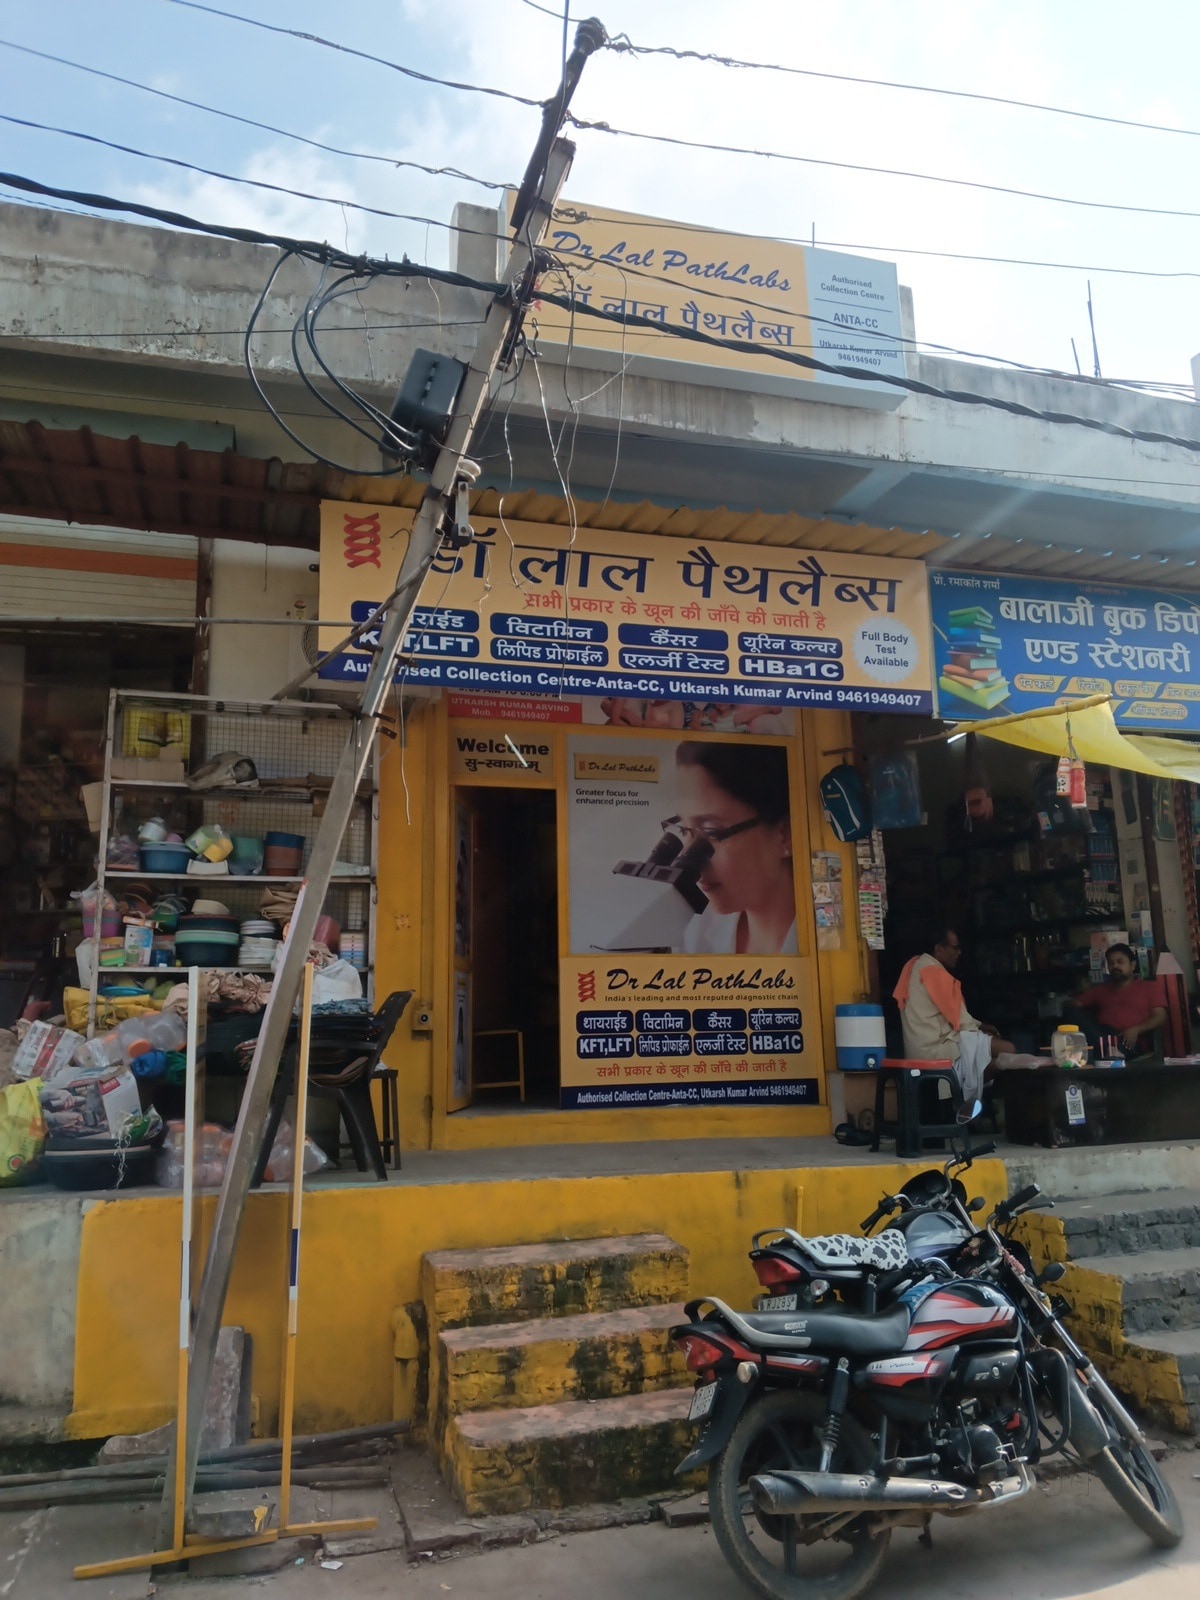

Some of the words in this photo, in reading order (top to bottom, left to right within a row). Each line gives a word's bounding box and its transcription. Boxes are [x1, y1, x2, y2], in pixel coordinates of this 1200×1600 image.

[552, 231, 594, 256] Dr
[599, 241, 655, 267] Lal
[663, 249, 792, 291] PathLabs
[832, 274, 872, 288] Authorised
[821, 283, 858, 296] Collection
[860, 290, 885, 300] Centre
[601, 296, 668, 323] लाल
[680, 300, 795, 348] पैथलैब्स
[833, 312, 878, 328] ANTA-CC
[820, 340, 848, 350] Utkarsh
[837, 353, 881, 365] 9461949407
[514, 544, 654, 593] लाल
[677, 545, 903, 613] पैथलैब्स
[526, 590, 561, 610] सभी
[570, 593, 615, 613] प्रकार
[621, 596, 637, 615] के
[643, 602, 674, 623] खून
[681, 602, 701, 621] की
[746, 606, 767, 625] की
[772, 610, 809, 629] जाती
[812, 612, 828, 631] है
[999, 596, 1094, 627] बालाजी
[1102, 605, 1146, 635] बुक
[506, 615, 593, 639] विटामिन
[359, 629, 474, 652] KT,LFT
[743, 634, 785, 654] यूरिन
[790, 638, 837, 654] कल्चर
[861, 631, 880, 642] Full
[884, 633, 909, 645] Body
[497, 638, 541, 658] लिपिड
[545, 641, 603, 664] प्रोफाईल
[875, 645, 896, 655] Test
[1024, 638, 1079, 664] एण्ड
[1088, 638, 1191, 673] स्टेशनरी
[623, 651, 682, 671] एलर्जी
[687, 653, 725, 672] टेस्ट
[744, 657, 840, 679] HBa1C
[863, 655, 909, 668] Available
[343, 659, 440, 678] Aurised
[446, 667, 532, 684] Collection
[669, 681, 729, 697] Utkarsh
[734, 684, 781, 699] Kumar
[786, 687, 832, 702] Arvind
[837, 689, 921, 706] 9461949407
[451, 697, 497, 707] UTKARSH
[499, 701, 533, 710] KUMAR
[535, 704, 570, 712] ARVIND
[501, 710, 551, 720] 9461949407
[457, 738, 550, 755] Welcome
[588, 762, 600, 770] Dr
[601, 763, 616, 771] Lal
[619, 763, 655, 772] PathLabs
[576, 788, 604, 796] Greater
[606, 789, 627, 797] focus
[576, 797, 614, 805] enhanced
[606, 968, 639, 990] Dr
[643, 968, 686, 990] Lal
[692, 967, 796, 990] PathLabs
[634, 995, 664, 1003] leading
[703, 994, 734, 1002] reputed
[735, 994, 776, 1002] diagnostic
[583, 1011, 627, 1032] थायराईड
[642, 1012, 684, 1030] विटामिन
[751, 1008, 773, 1030] यूरिन
[774, 1013, 799, 1025] कल्चर
[580, 1037, 632, 1056] KFT,LFT
[639, 1035, 661, 1053] लिपिड
[695, 1034, 725, 1054] एलर्जी
[726, 1034, 746, 1051] टेस्ट
[752, 1035, 801, 1051] HBa1C
[597, 1063, 620, 1078] सभी
[624, 1065, 652, 1077] प्रकार
[656, 1061, 667, 1075] के
[670, 1064, 690, 1079] खून
[694, 1061, 707, 1075] की
[736, 1060, 749, 1073] की
[752, 1059, 776, 1073] जाती
[778, 1058, 787, 1073] है
[577, 1091, 613, 1104] Authorised
[614, 1090, 647, 1102] Collection
[701, 1086, 726, 1099] Utkarsh
[727, 1085, 748, 1098] Kumar
[750, 1085, 769, 1097] Arvind
[770, 1084, 807, 1097] 9461949407
